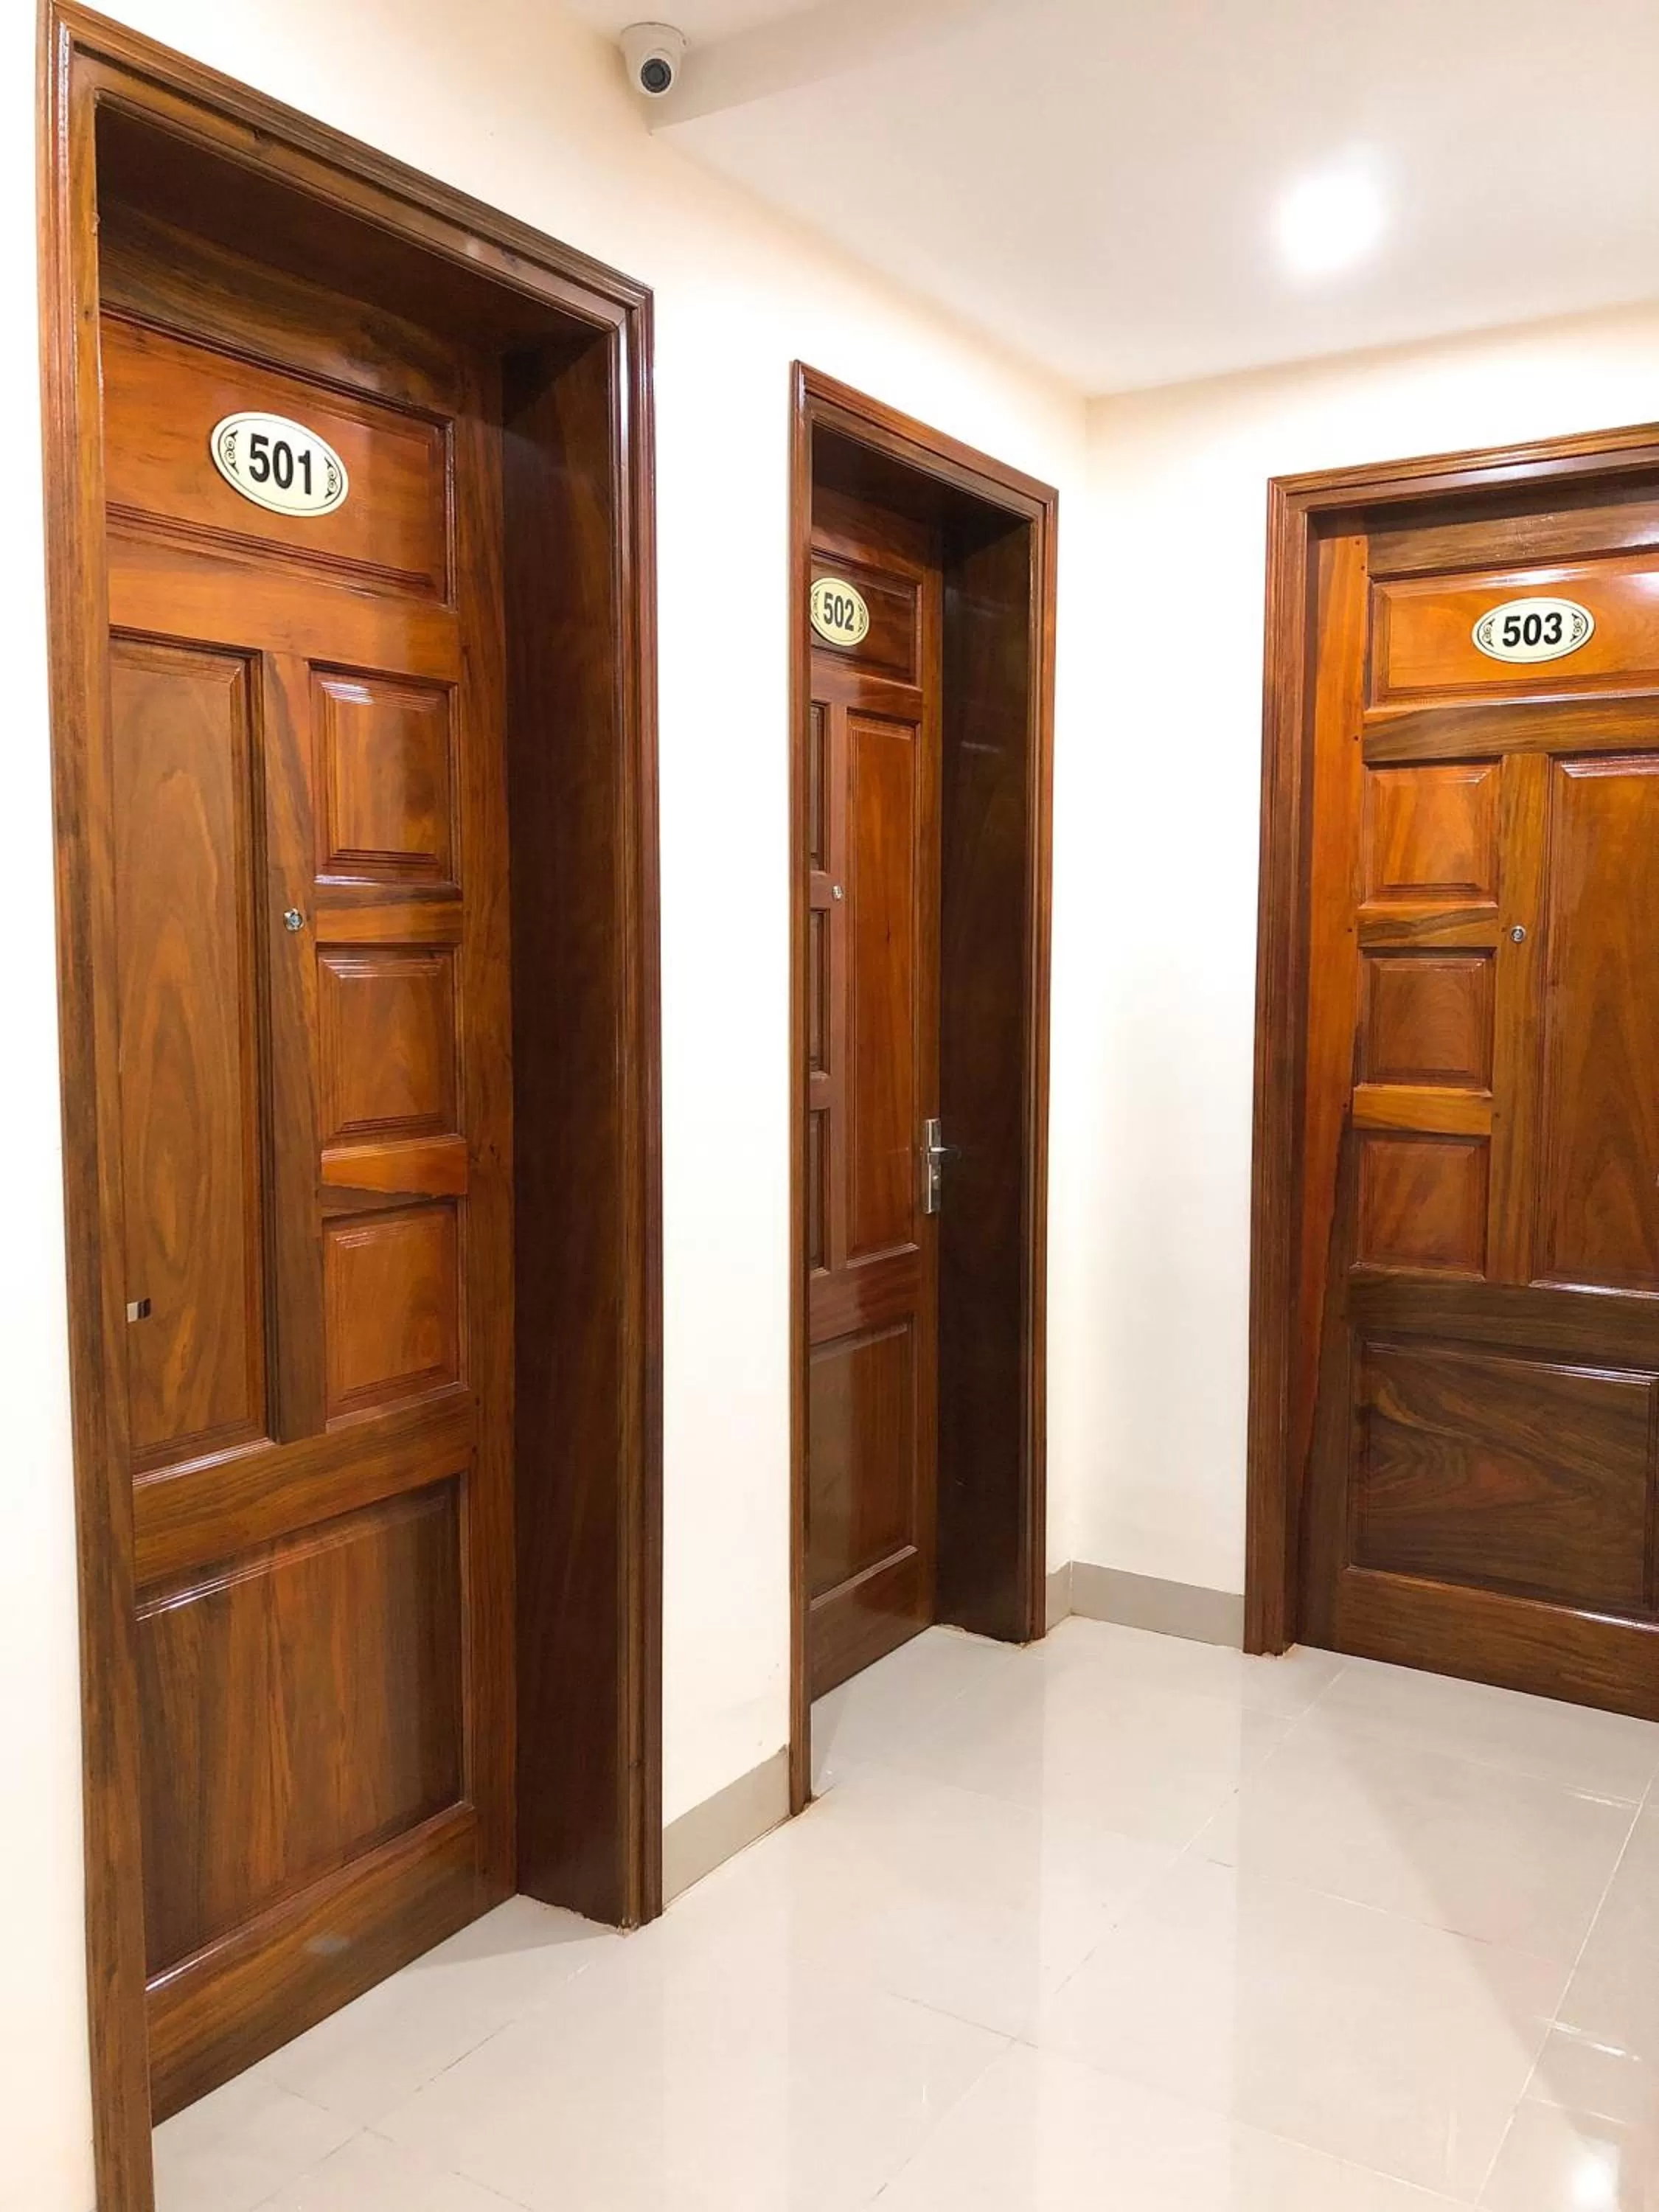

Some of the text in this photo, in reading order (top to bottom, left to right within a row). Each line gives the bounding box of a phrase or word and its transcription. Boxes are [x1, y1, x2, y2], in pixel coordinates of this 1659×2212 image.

[249, 433, 311, 495] 501
[824, 592, 855, 631] 502
[1502, 612, 1562, 647] 503
